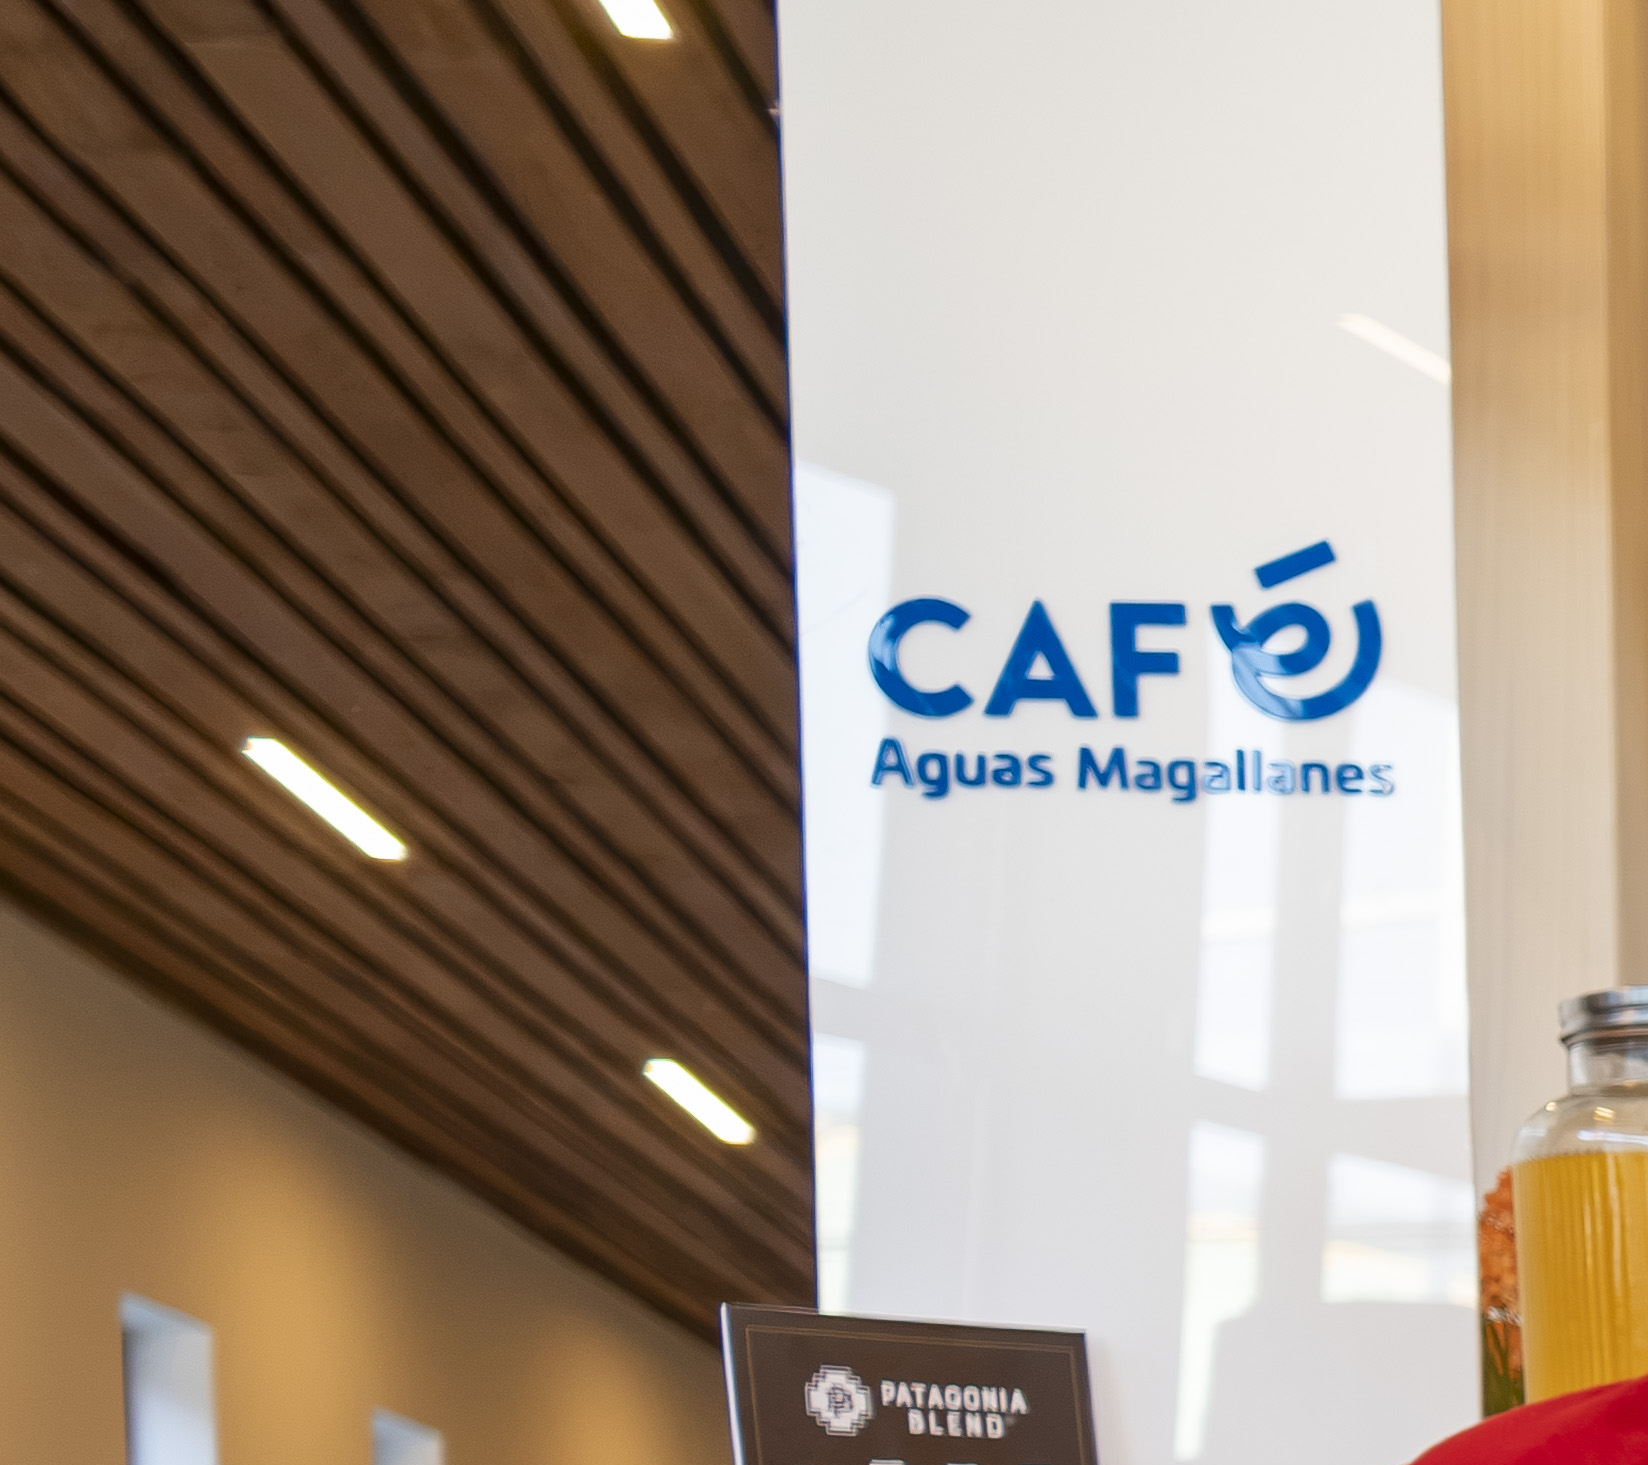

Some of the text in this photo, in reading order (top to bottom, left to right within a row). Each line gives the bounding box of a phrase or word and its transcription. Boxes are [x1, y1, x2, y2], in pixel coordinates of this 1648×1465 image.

[870, 737, 1396, 805] Aguas Magallanes
[880, 1379, 1031, 1415] PATAGONIA
[908, 1408, 1006, 1439] BLEND
